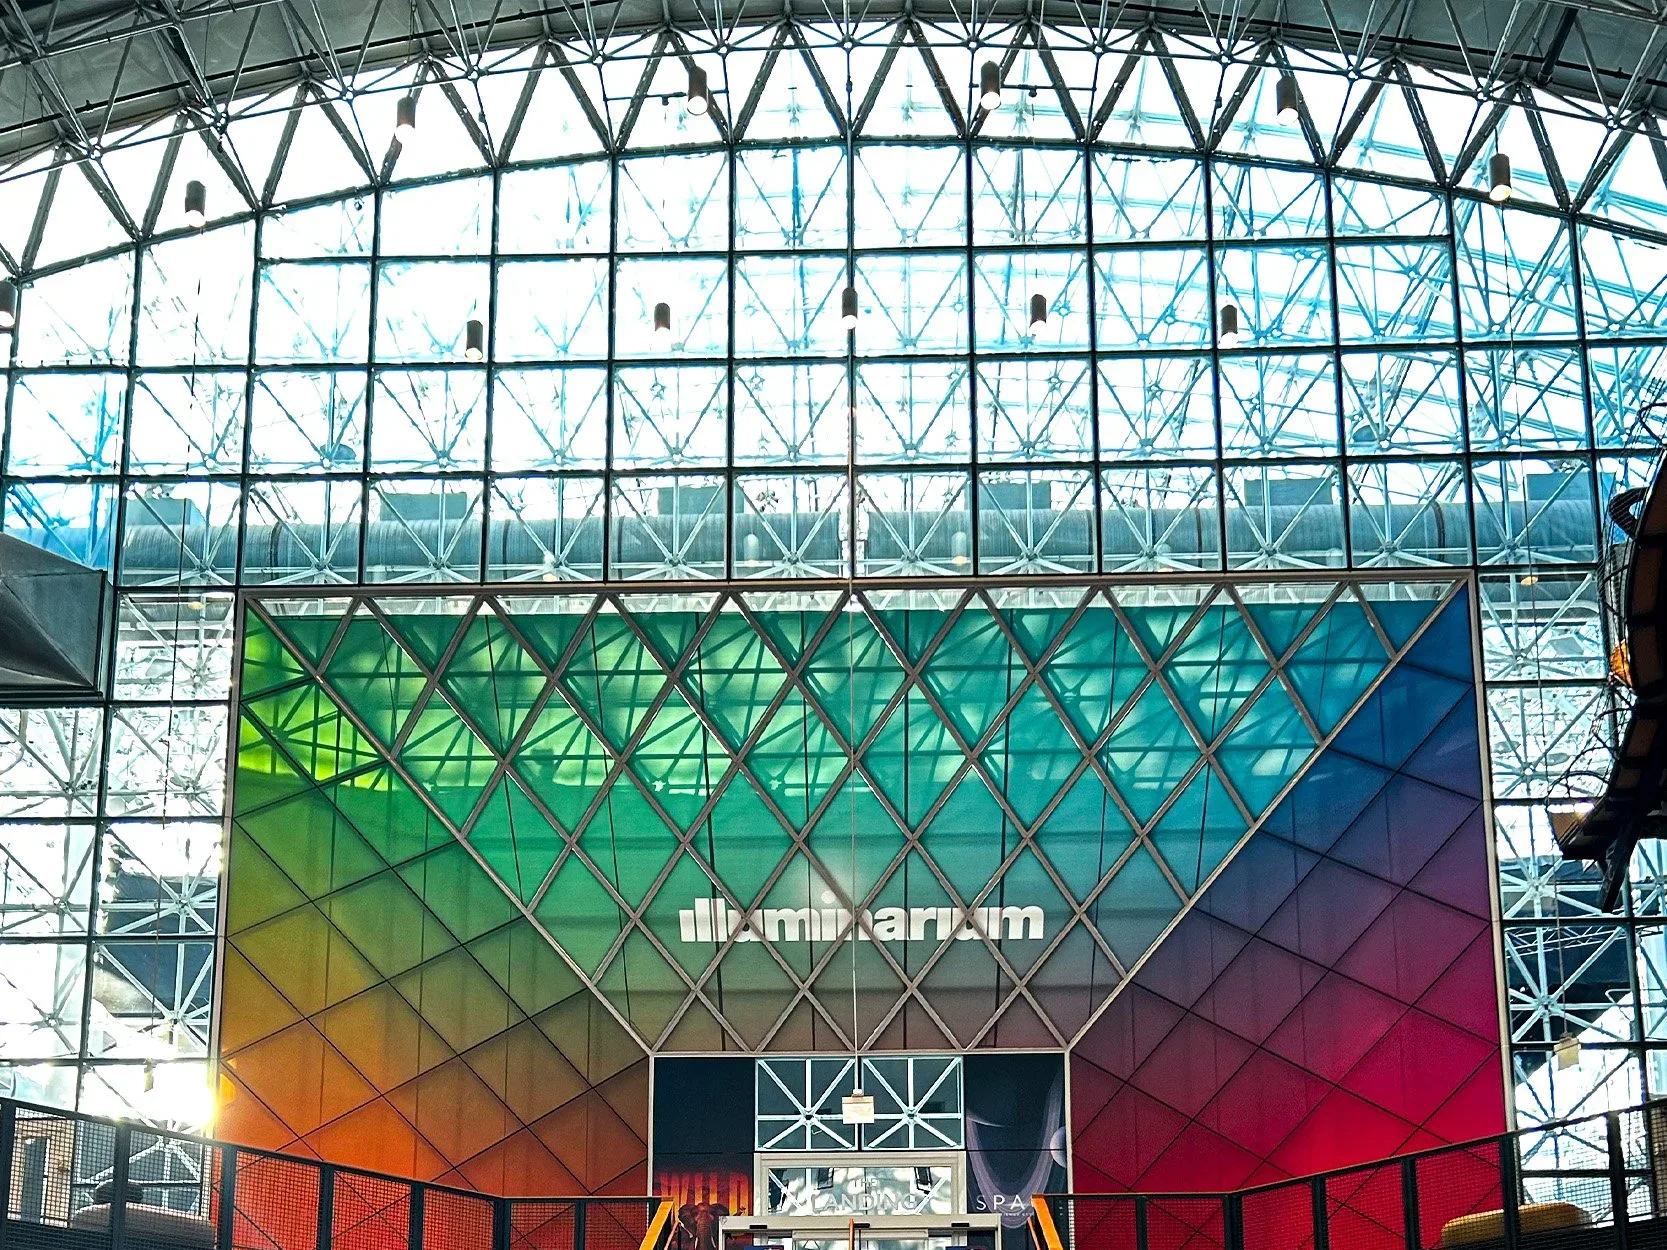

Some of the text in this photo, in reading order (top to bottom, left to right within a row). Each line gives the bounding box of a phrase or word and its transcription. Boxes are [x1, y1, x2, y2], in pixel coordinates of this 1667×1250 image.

[679, 890, 1044, 942] illuminarium
[853, 1177, 879, 1189] THE
[810, 1193, 918, 1212] LANDING
[976, 1194, 1027, 1212] SPA
